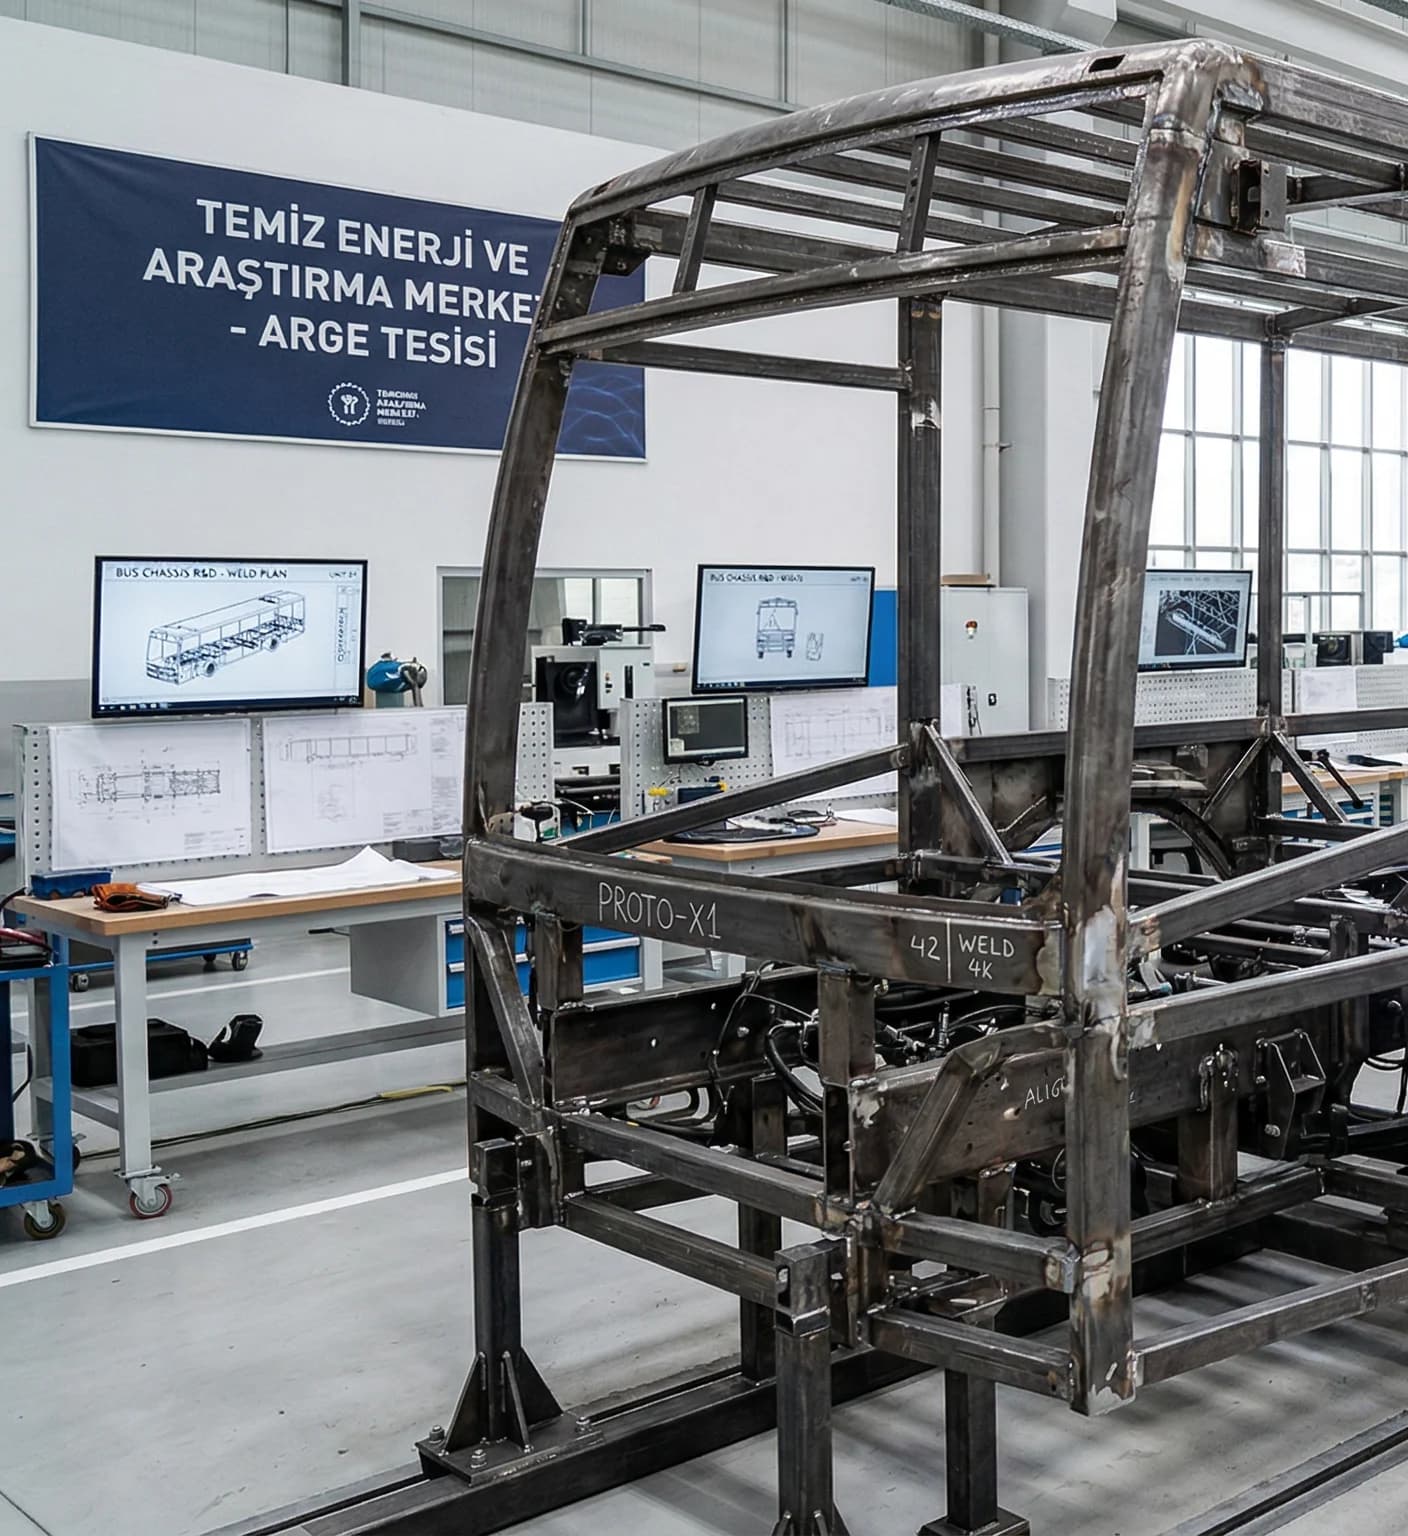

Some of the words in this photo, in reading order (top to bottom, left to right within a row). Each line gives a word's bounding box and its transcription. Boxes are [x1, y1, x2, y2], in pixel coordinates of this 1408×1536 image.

[196, 198, 326, 249] TEMİZ
[338, 218, 473, 269] ENERJİ
[483, 239, 529, 276] VE
[142, 247, 394, 309] ARAŞTIRMA
[404, 278, 541, 325] MERKE
[229, 324, 247, 335] -
[258, 314, 369, 357] ARGE
[381, 325, 497, 369] TESİSİ
[116, 567, 139, 578] BUS
[260, 568, 288, 579] PLAN
[599, 881, 722, 939] PROTO-X1
[910, 935, 941, 961] 42
[958, 932, 1015, 958] WELD
[968, 957, 993, 980] 4K
[1024, 1076, 1067, 1110] ALIG
